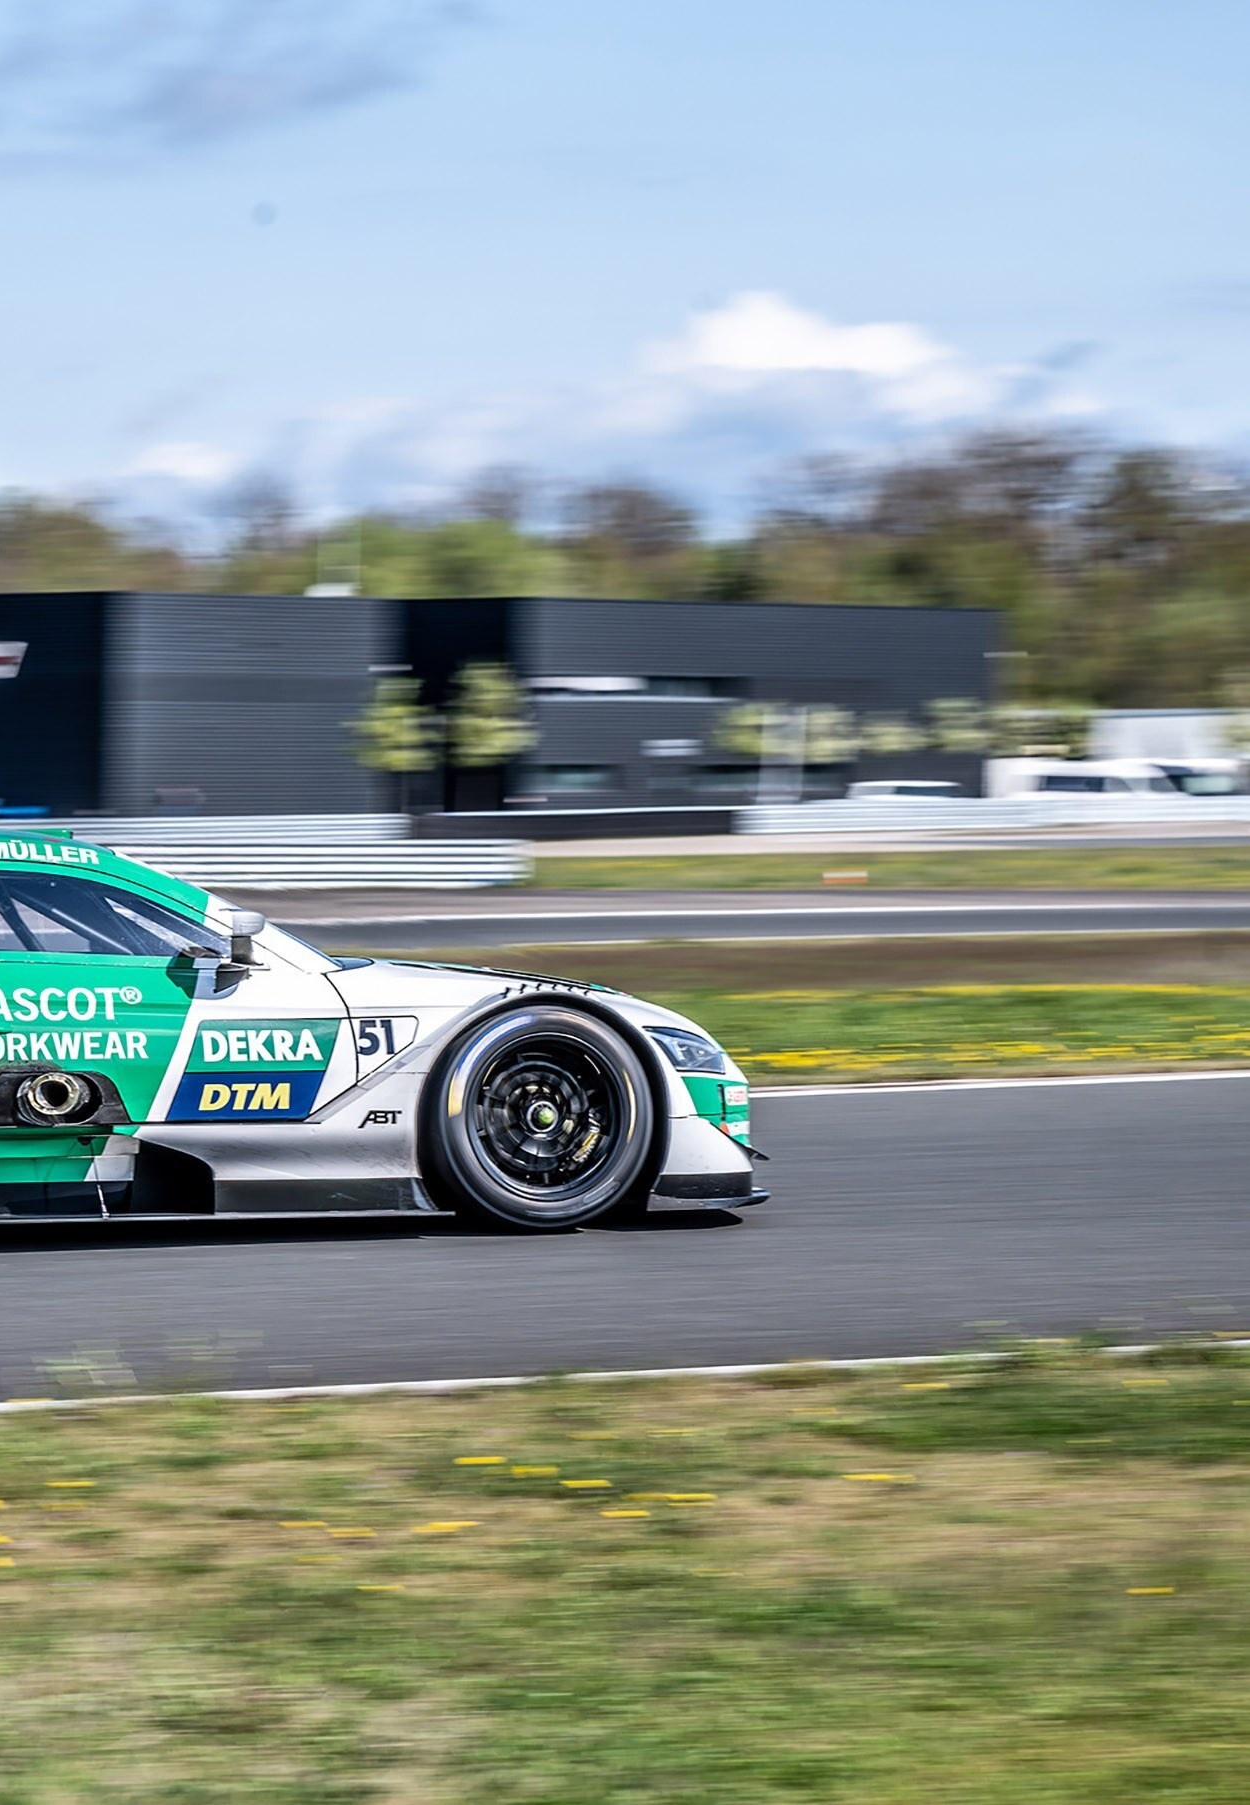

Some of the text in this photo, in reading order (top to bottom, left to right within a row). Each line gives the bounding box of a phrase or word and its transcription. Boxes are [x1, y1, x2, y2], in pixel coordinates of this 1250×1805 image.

[201, 1028, 323, 1062] DEKRA
[357, 1019, 396, 1056] 51
[198, 1082, 291, 1111] DTM
[358, 1110, 402, 1129] ABT
